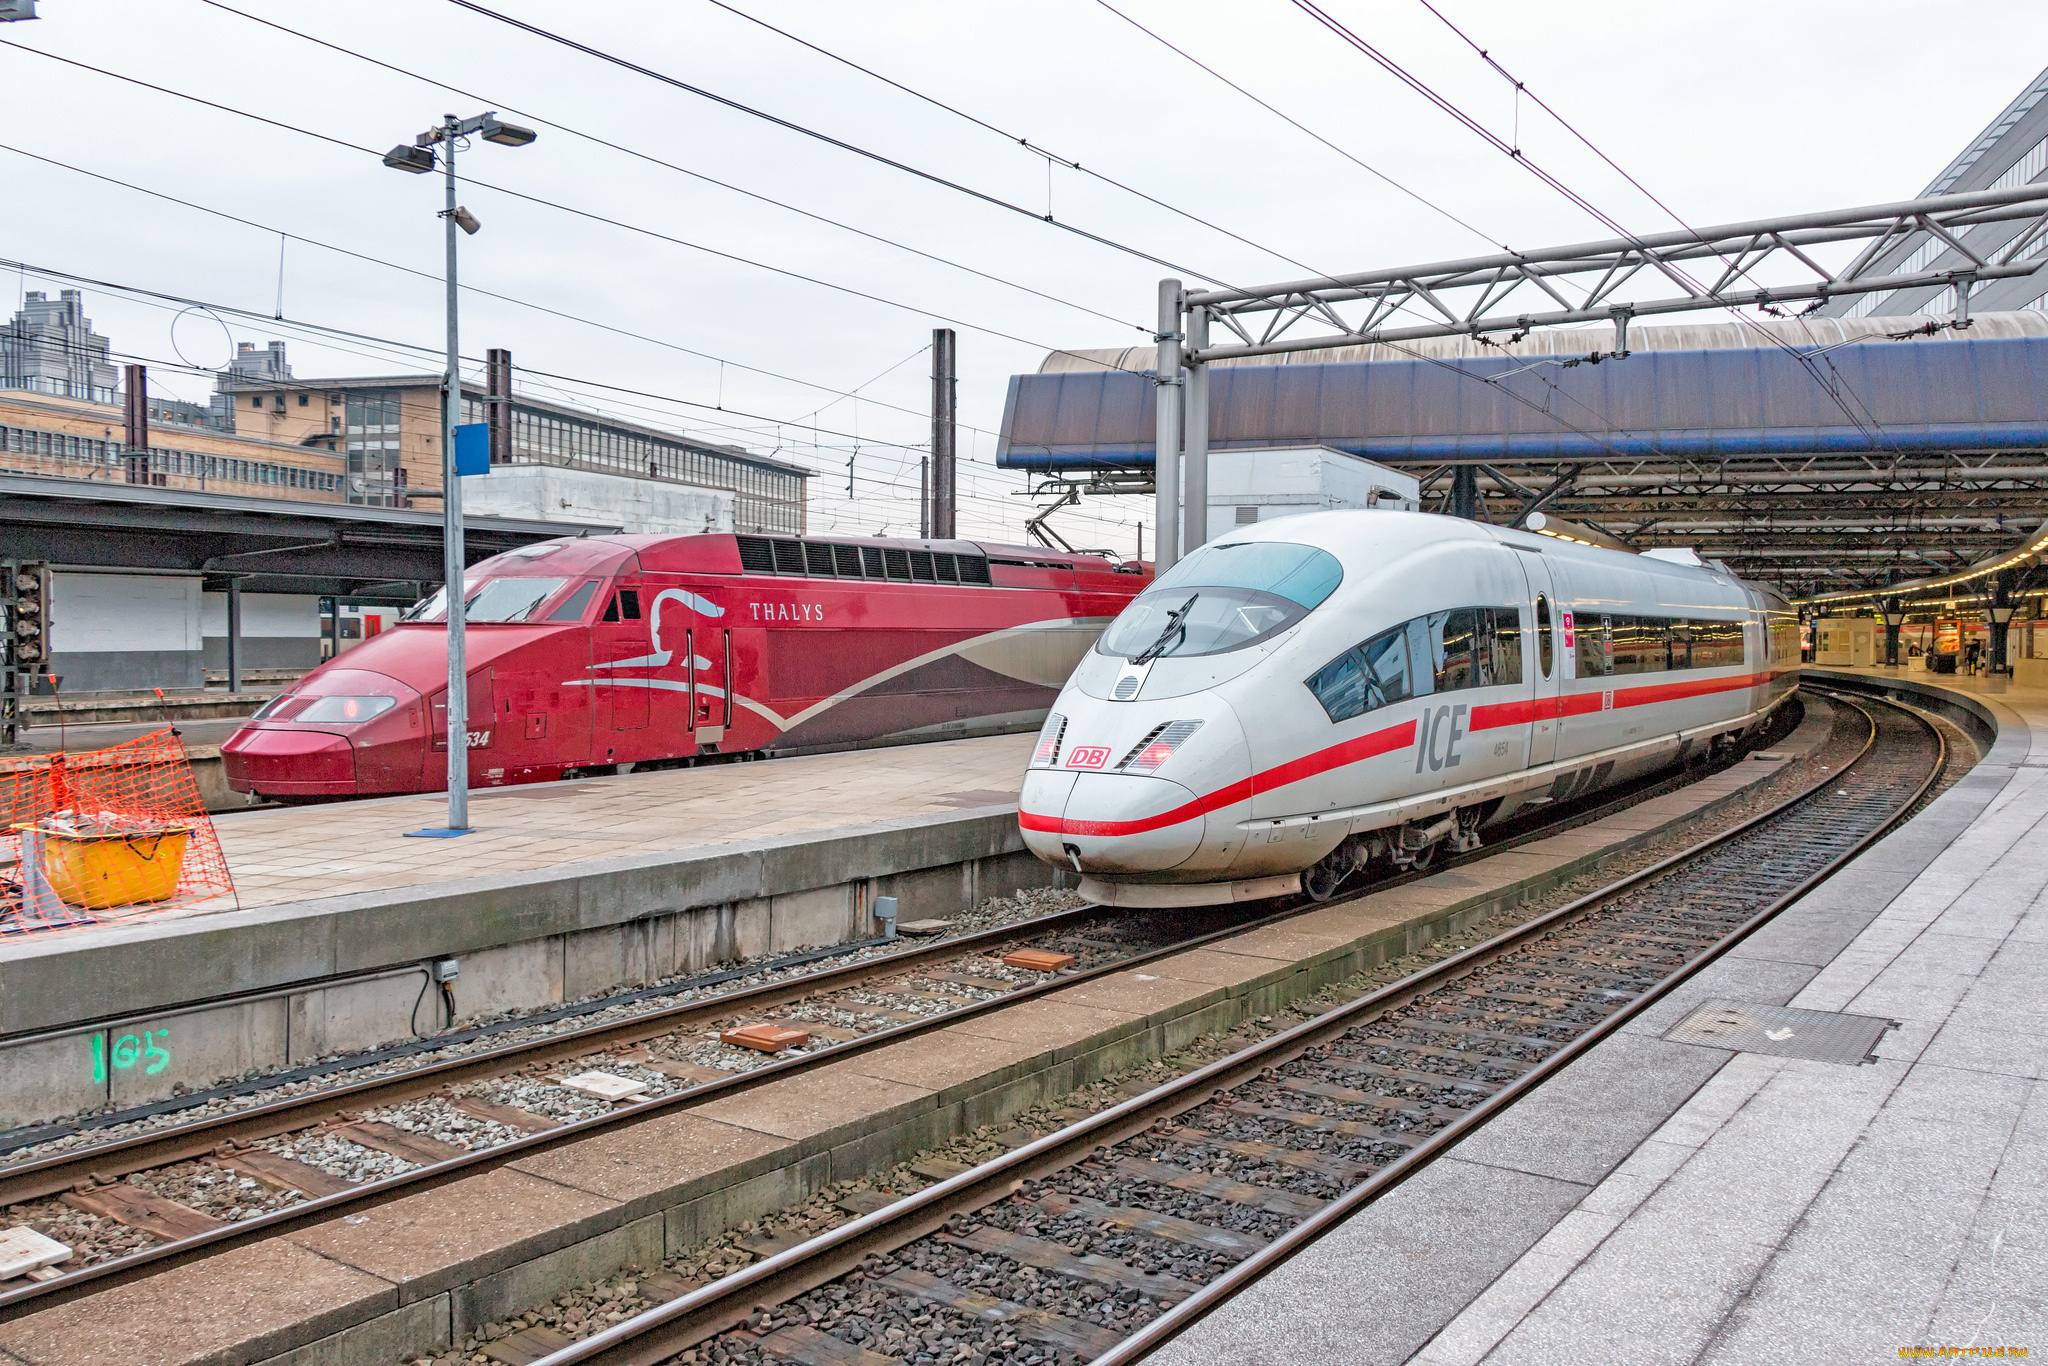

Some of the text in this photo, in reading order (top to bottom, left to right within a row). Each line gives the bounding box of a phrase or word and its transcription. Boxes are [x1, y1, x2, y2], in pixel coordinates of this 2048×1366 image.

[750, 603, 823, 620] THALYS
[1415, 704, 1468, 774] ICE
[1071, 749, 1104, 765] DB
